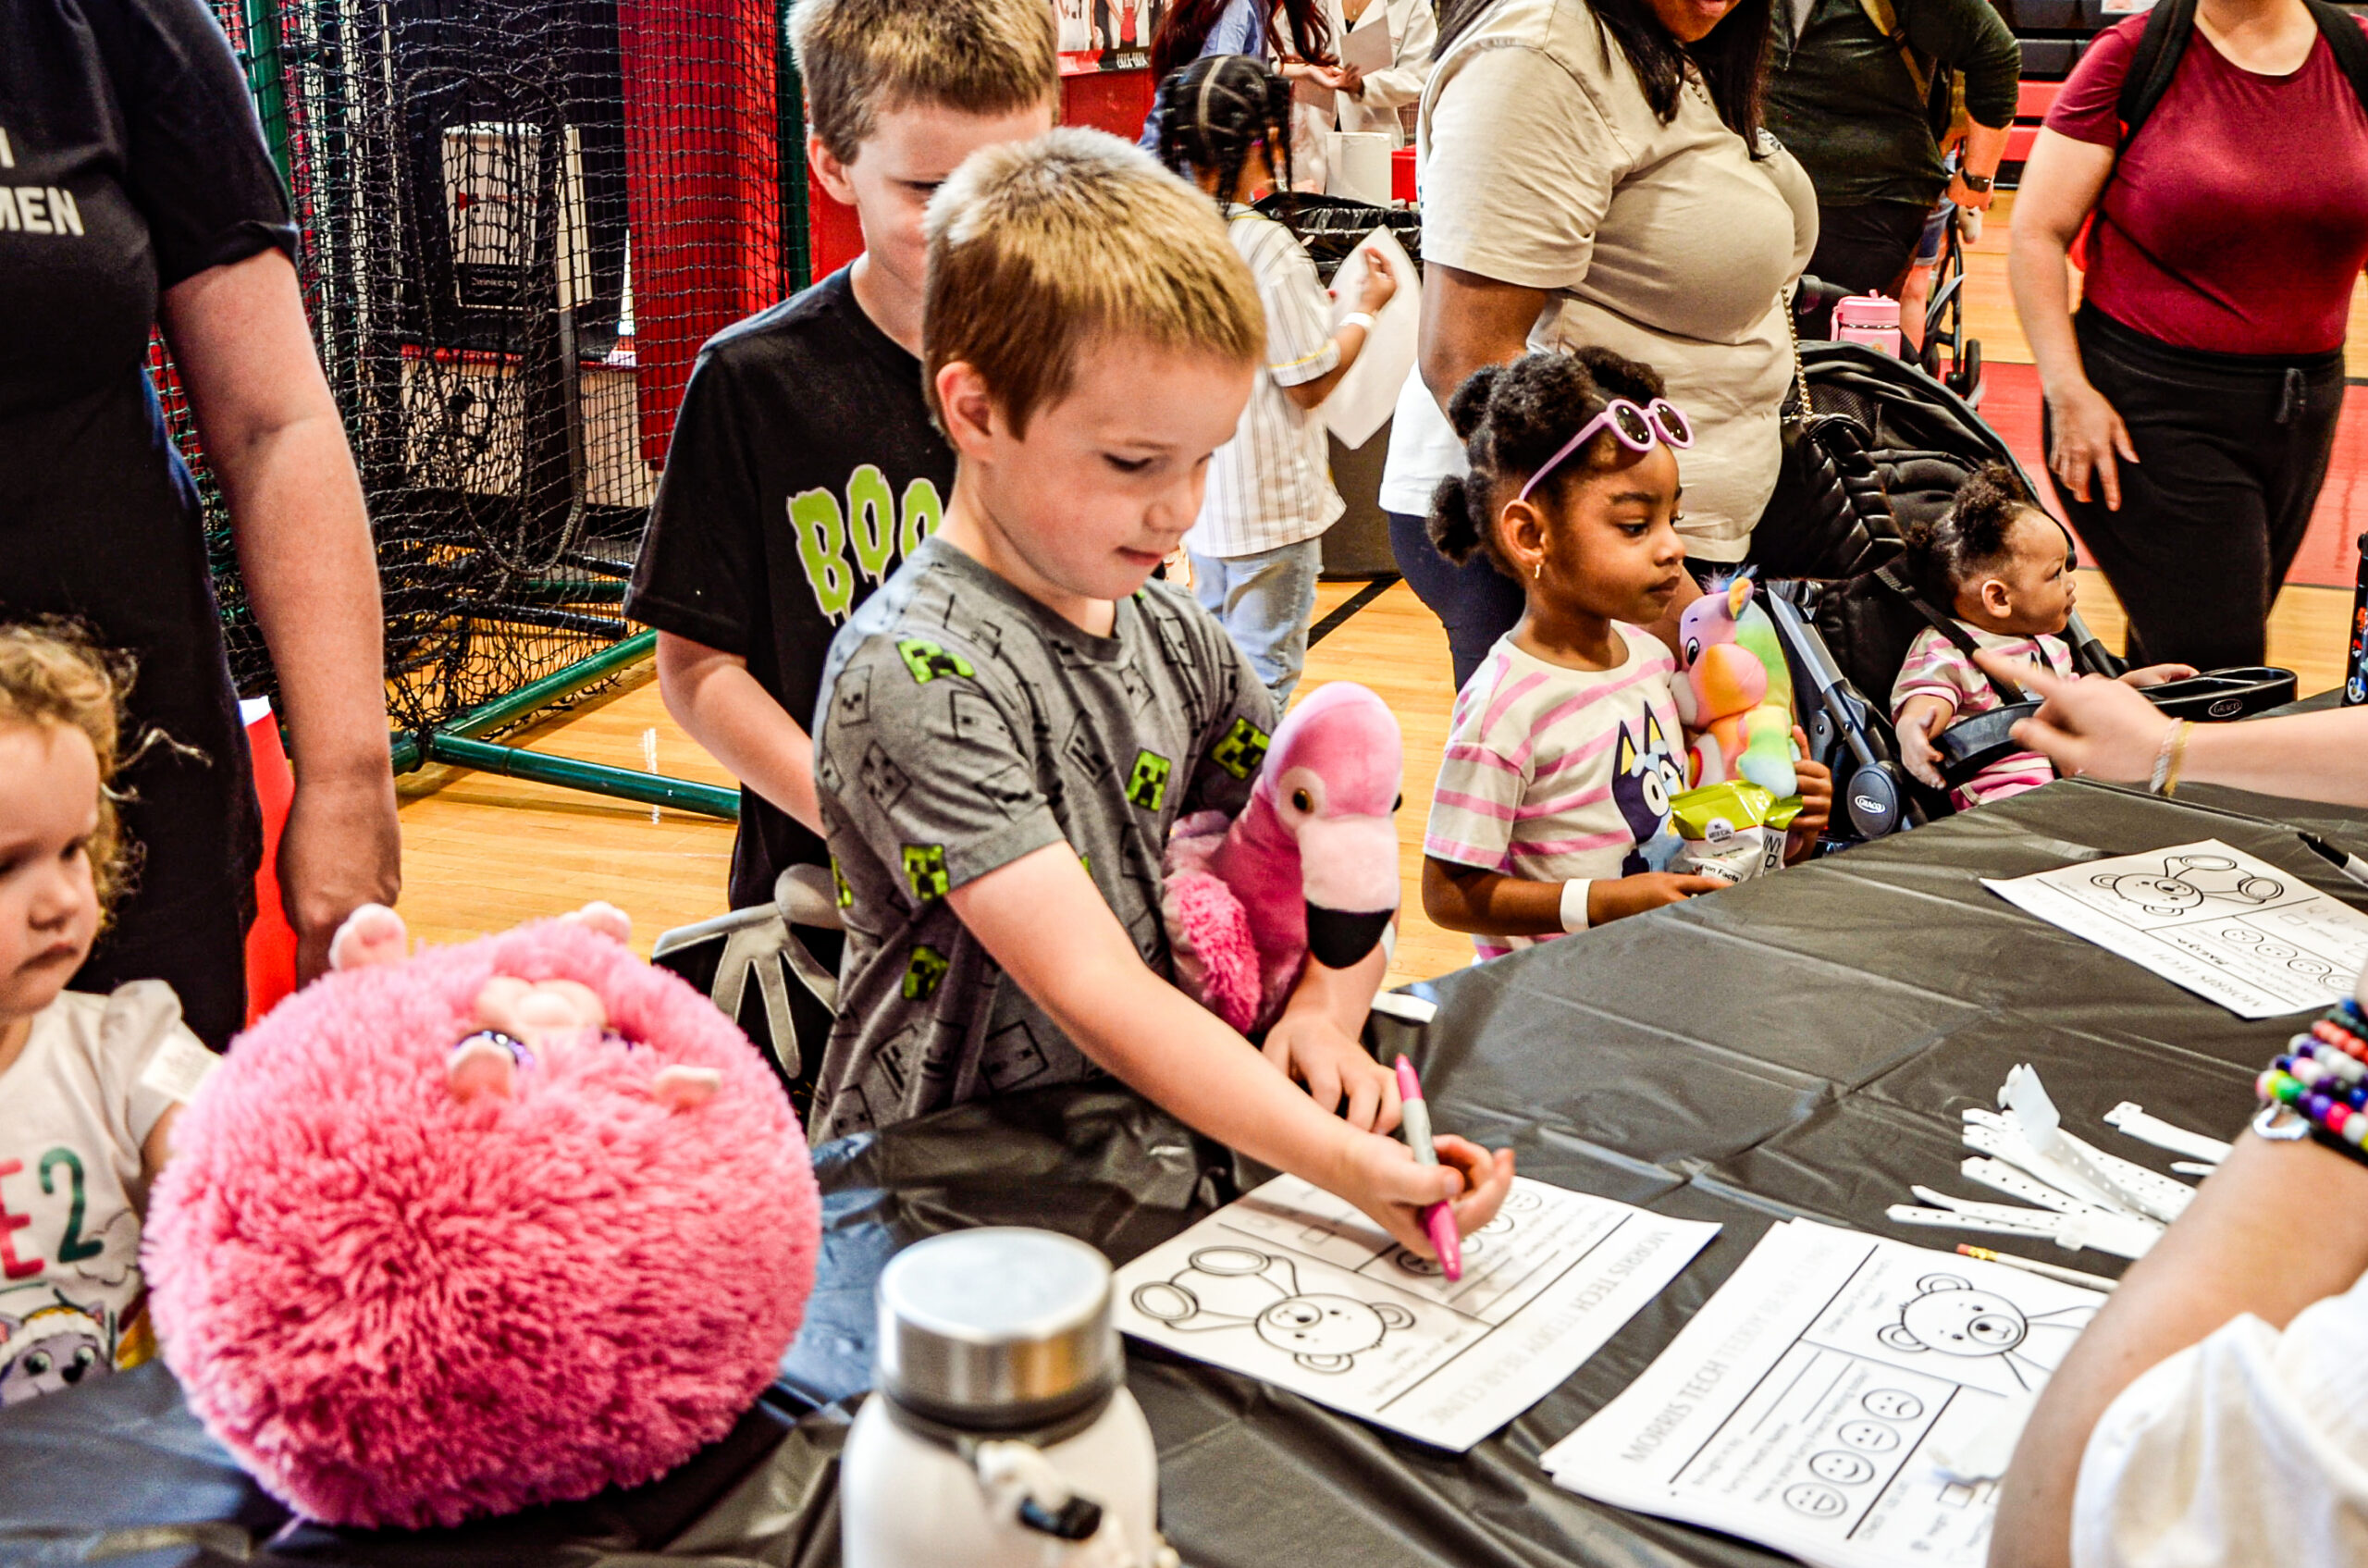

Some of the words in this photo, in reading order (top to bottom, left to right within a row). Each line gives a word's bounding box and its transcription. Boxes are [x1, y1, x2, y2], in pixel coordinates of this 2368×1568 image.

[1858, 798, 1883, 811] GRACO
[1718, 868, 1740, 883] Facts
[1567, 1278, 1620, 1311] TECH
[1618, 1399, 1696, 1463] MORRIS
[1675, 1358, 1733, 1397] TECH
